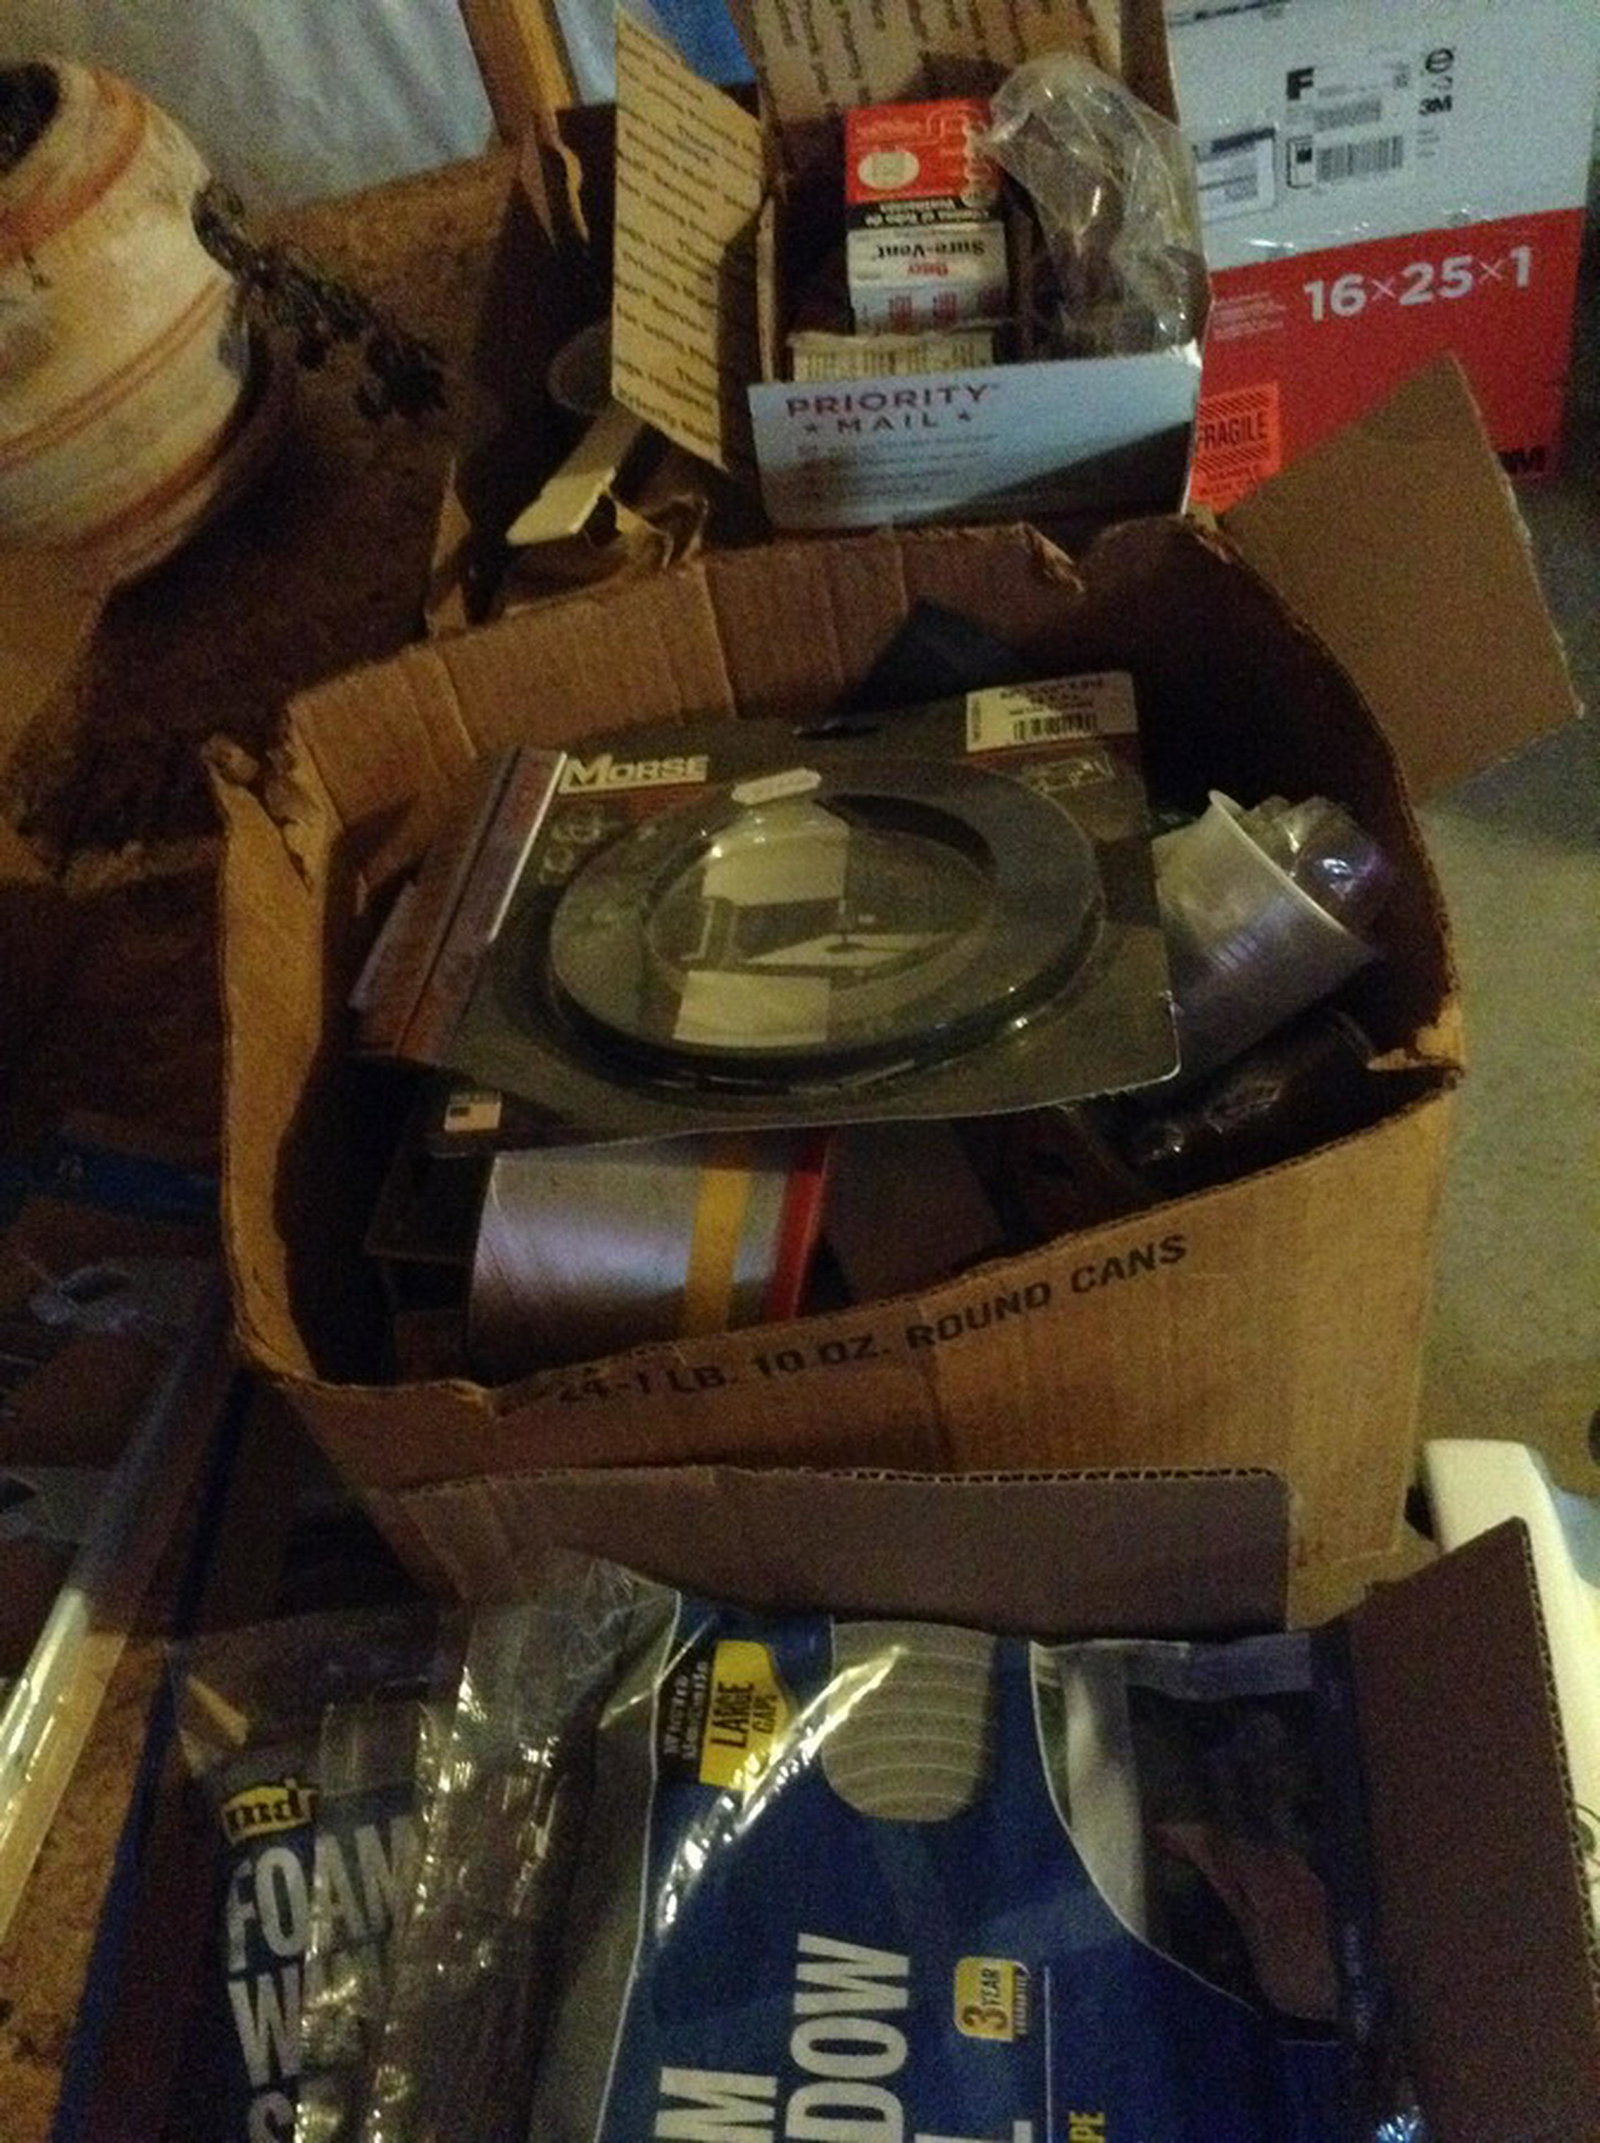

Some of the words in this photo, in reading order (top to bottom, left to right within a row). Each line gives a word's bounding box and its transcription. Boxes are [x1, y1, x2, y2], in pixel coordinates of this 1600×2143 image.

[1286, 67, 1315, 100] F
[1418, 95, 1453, 116] 3M
[786, 384, 989, 417] PRIORITY
[838, 412, 939, 434] MAIL
[752, 1349, 800, 1380] 10
[905, 1280, 1053, 1352] ROUND
[1069, 1233, 1190, 1291] CANS
[711, 1681, 754, 1750] LARGE
